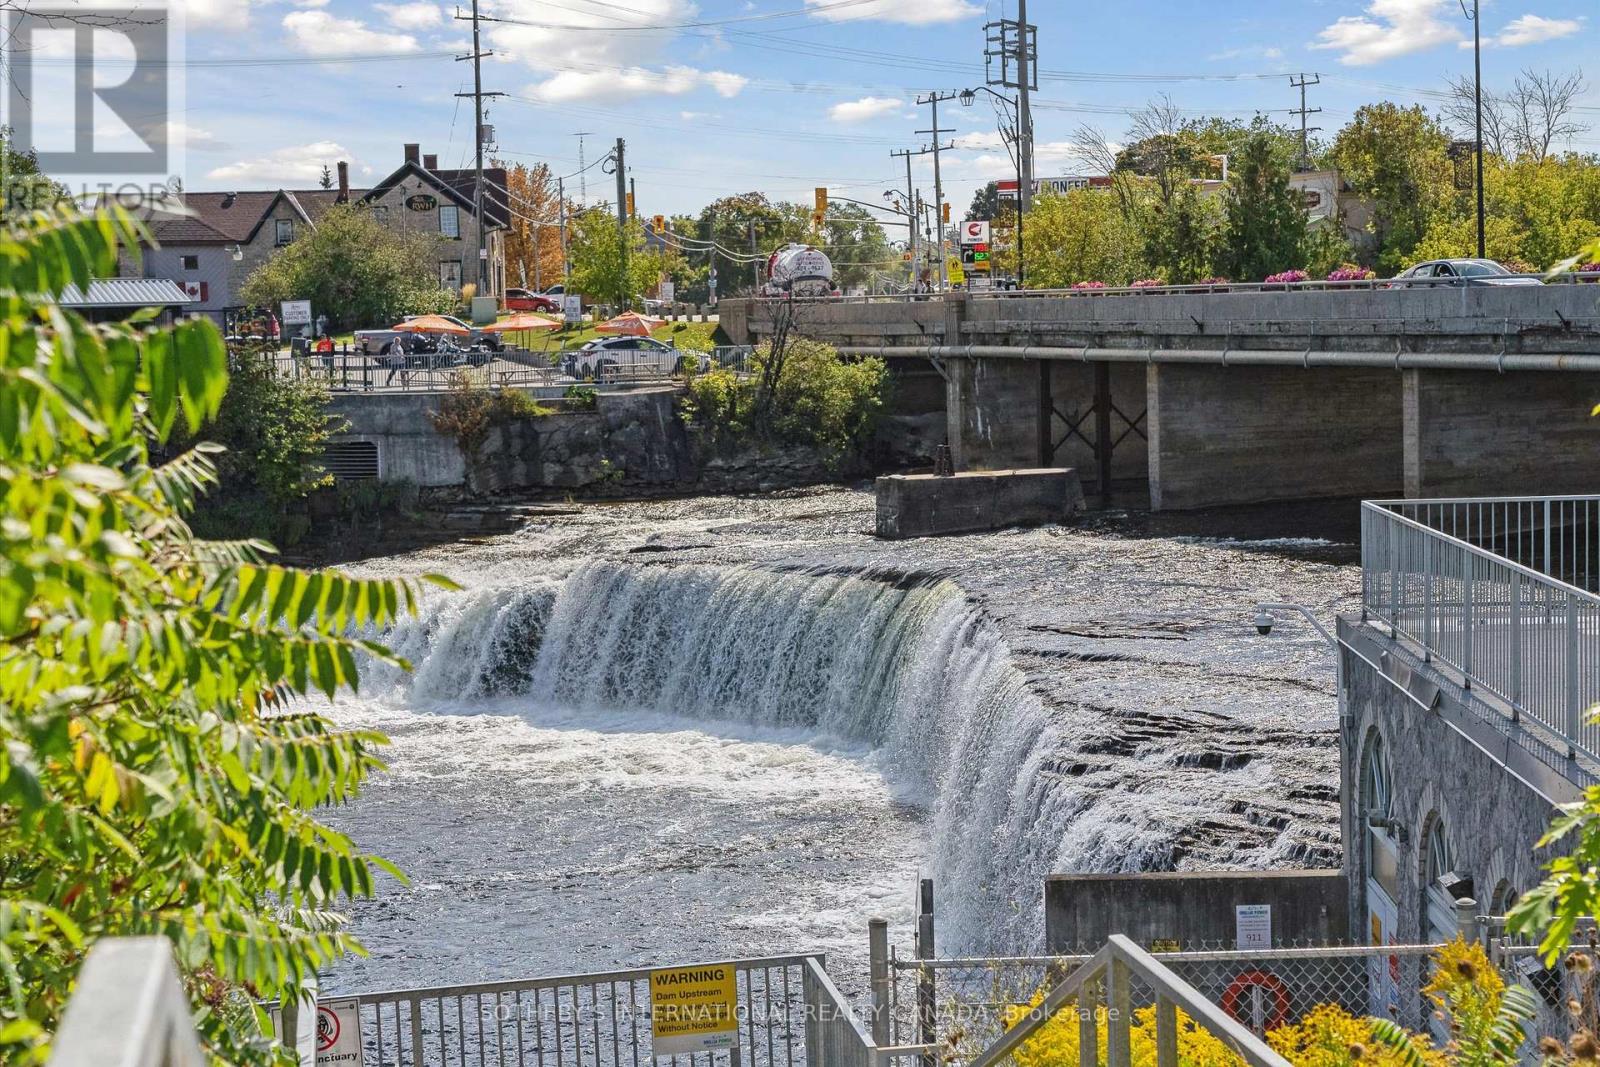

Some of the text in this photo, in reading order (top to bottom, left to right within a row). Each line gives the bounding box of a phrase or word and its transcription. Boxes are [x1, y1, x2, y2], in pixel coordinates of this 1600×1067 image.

[656, 969, 724, 986] WARNING
[656, 988, 722, 1000] Dam Upstream
[658, 1021, 718, 1033] Without Notice
[318, 1053, 357, 1063] nctuary
